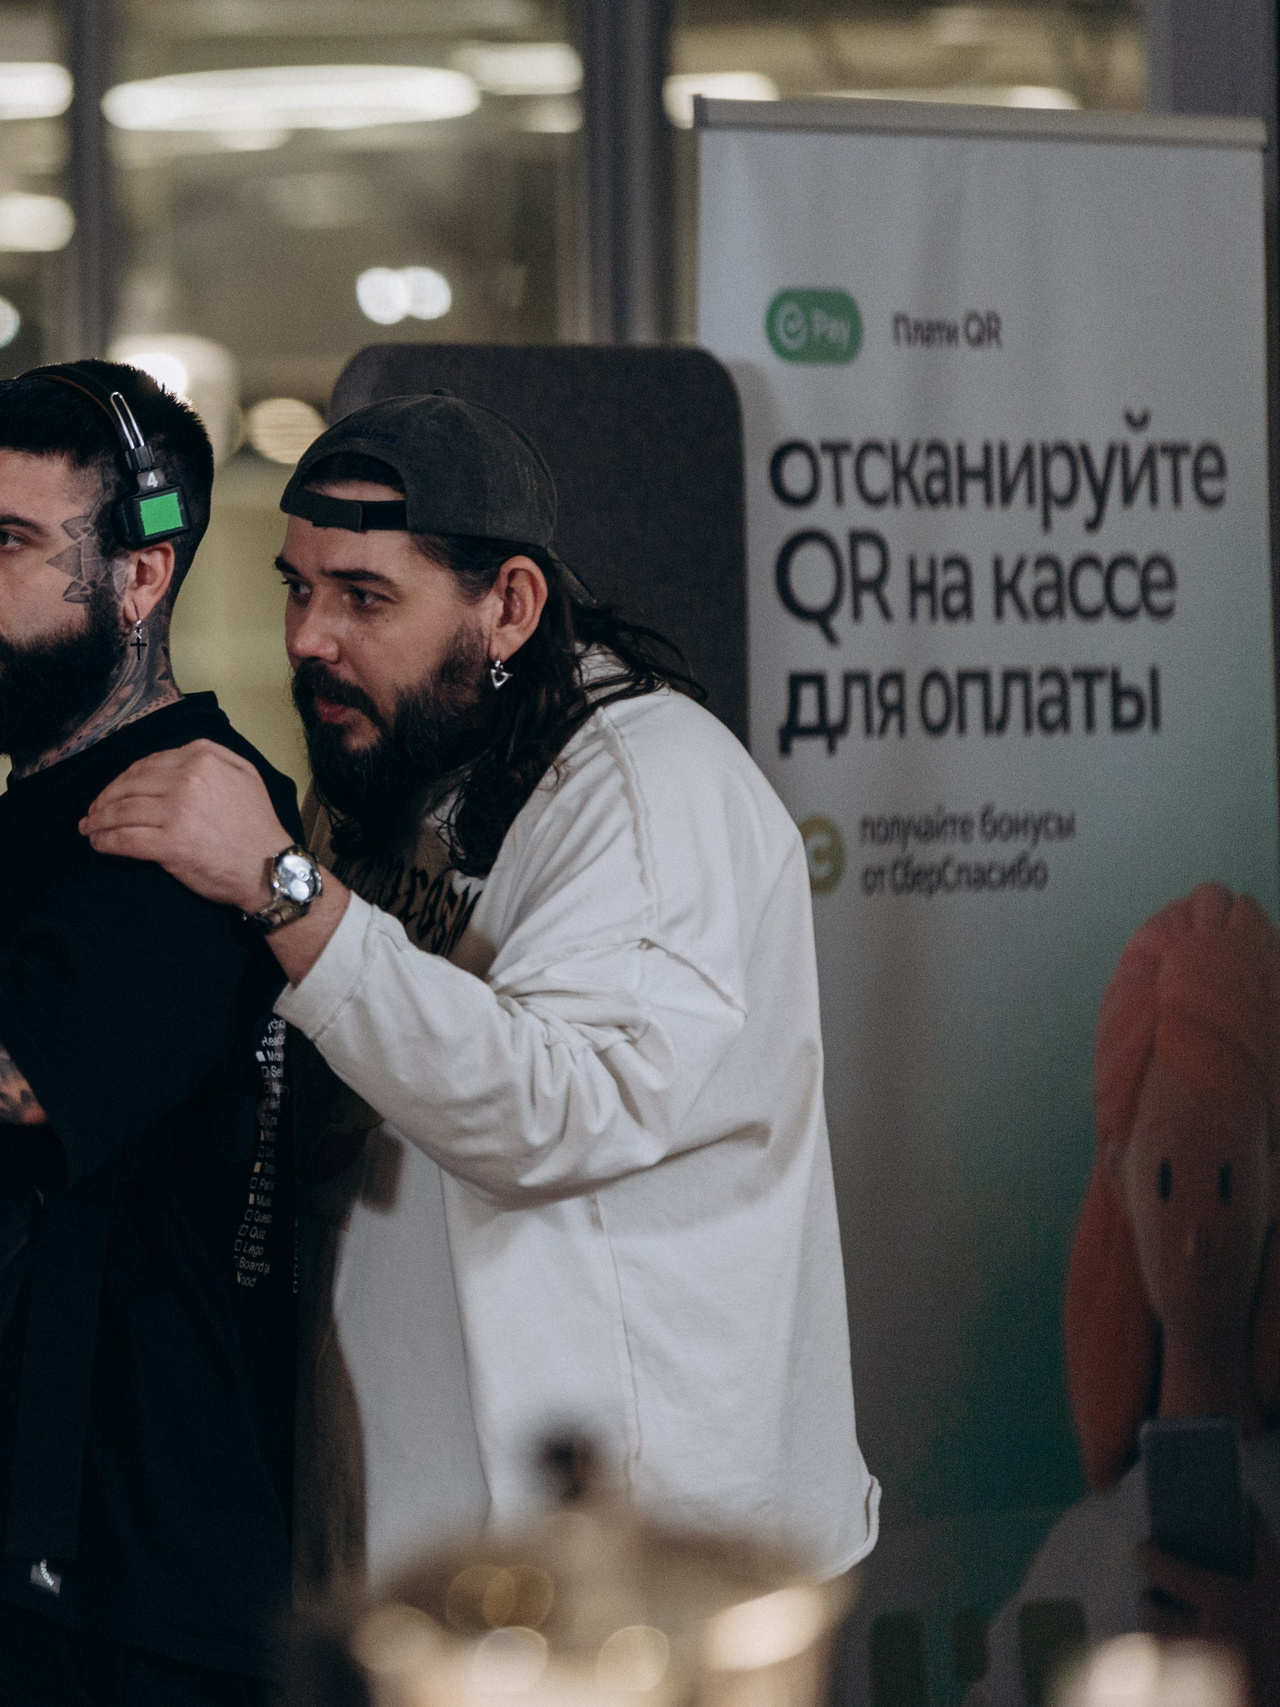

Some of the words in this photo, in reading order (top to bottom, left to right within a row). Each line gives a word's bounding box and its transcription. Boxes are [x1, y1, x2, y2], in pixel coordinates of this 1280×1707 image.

[892, 312, 959, 348] Плати
[963, 310, 1003, 349] QR
[147, 472, 158, 488] 4
[767, 408, 1229, 534] отсканируйте
[774, 528, 892, 646] QR
[907, 554, 974, 623] на
[992, 553, 1177, 623] кассе
[777, 669, 907, 758] для
[919, 665, 1162, 738] оплаты
[979, 804, 1077, 848] бонусы
[239, 1256, 265, 1273] Board
[243, 1241, 264, 1258] Lego
